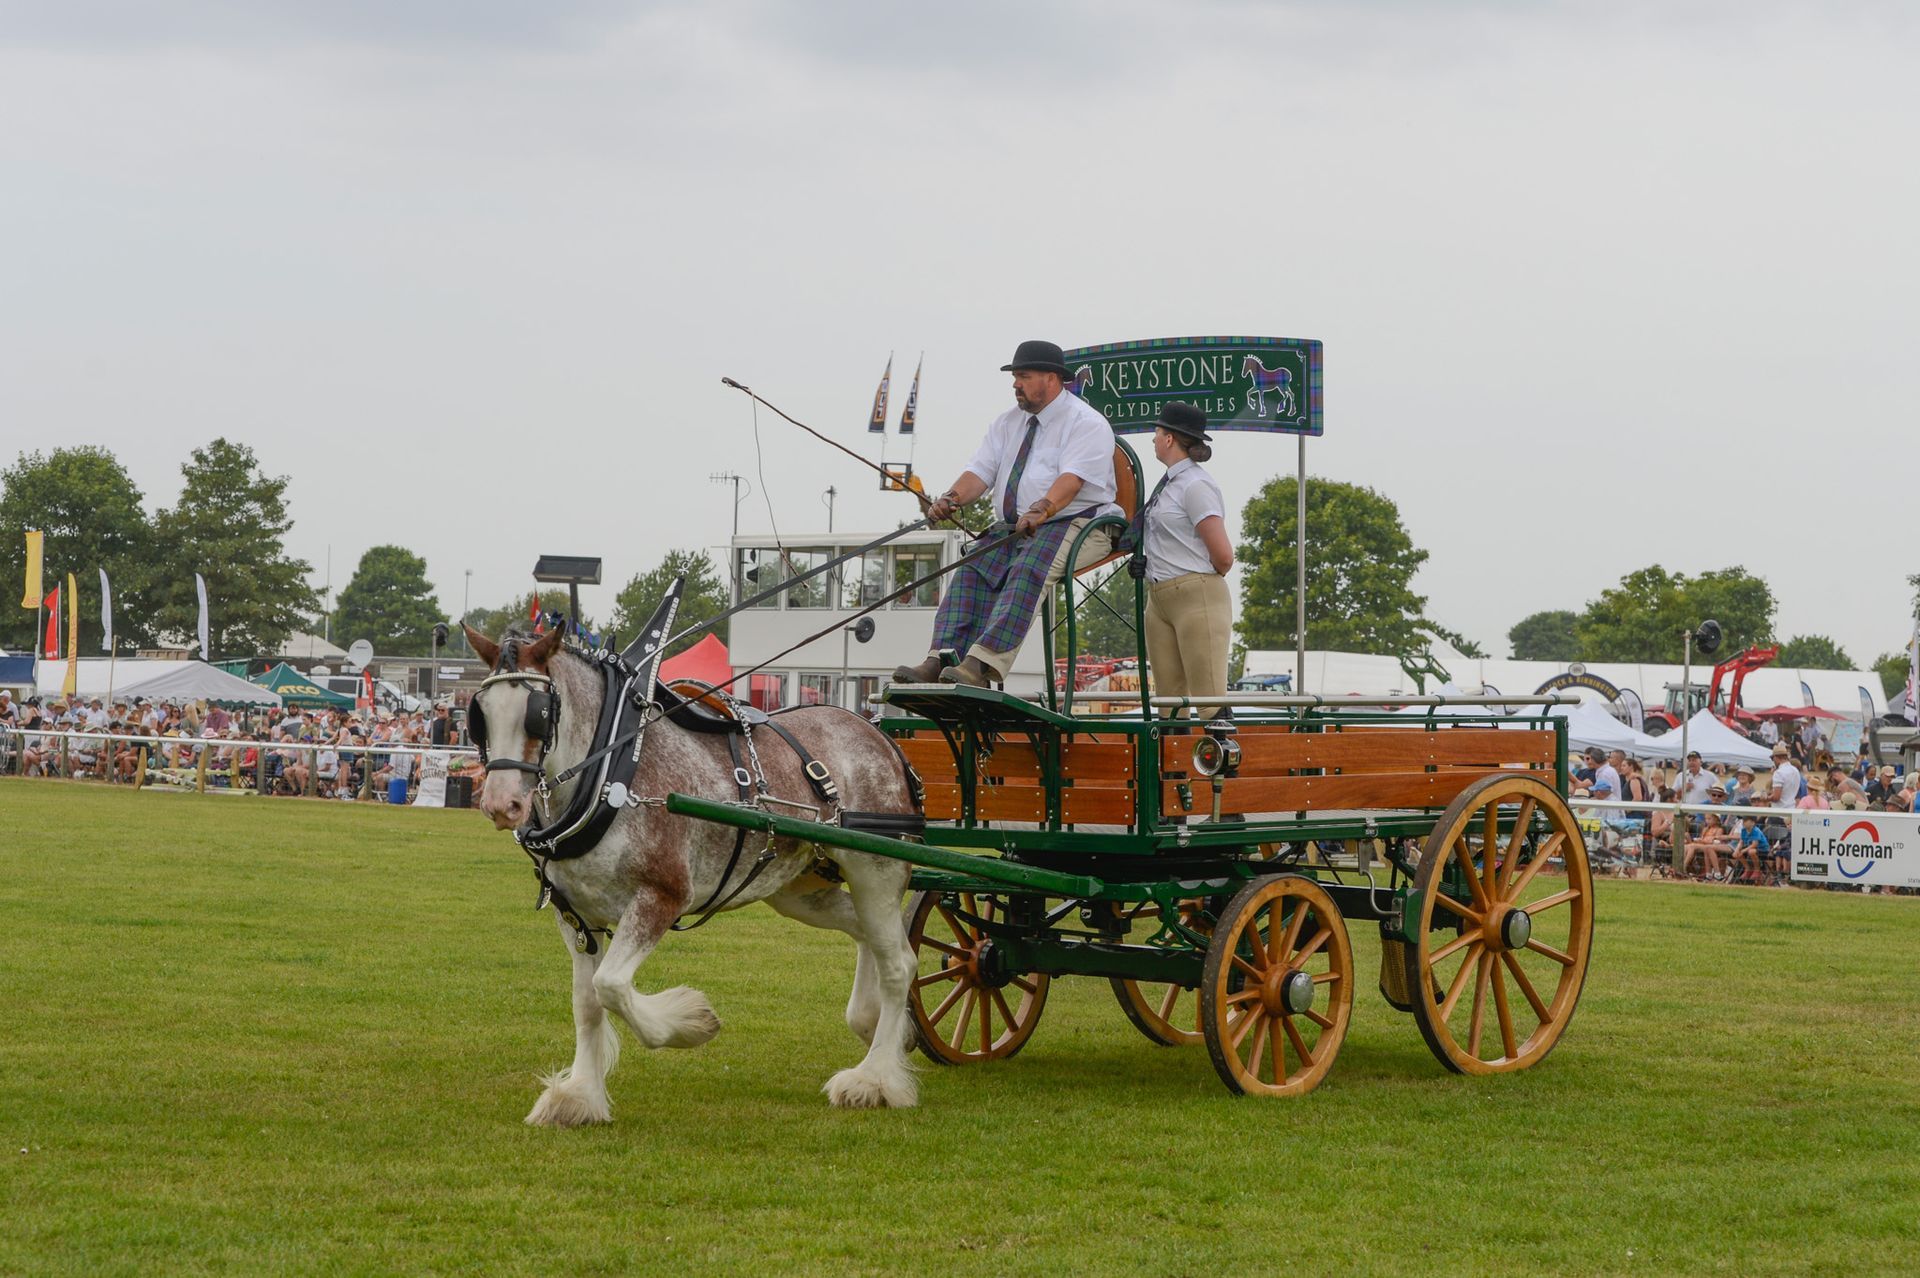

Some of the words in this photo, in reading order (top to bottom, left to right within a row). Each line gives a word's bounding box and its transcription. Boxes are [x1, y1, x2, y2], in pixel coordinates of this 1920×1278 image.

[1101, 355, 1234, 398] KEYSTONE
[1103, 397, 1236, 418] CLYDEALES
[277, 685, 320, 697] ATCO
[1799, 837, 1825, 855] J.H.
[1828, 838, 1893, 859] Foreman
[1892, 842, 1904, 850] LTD
